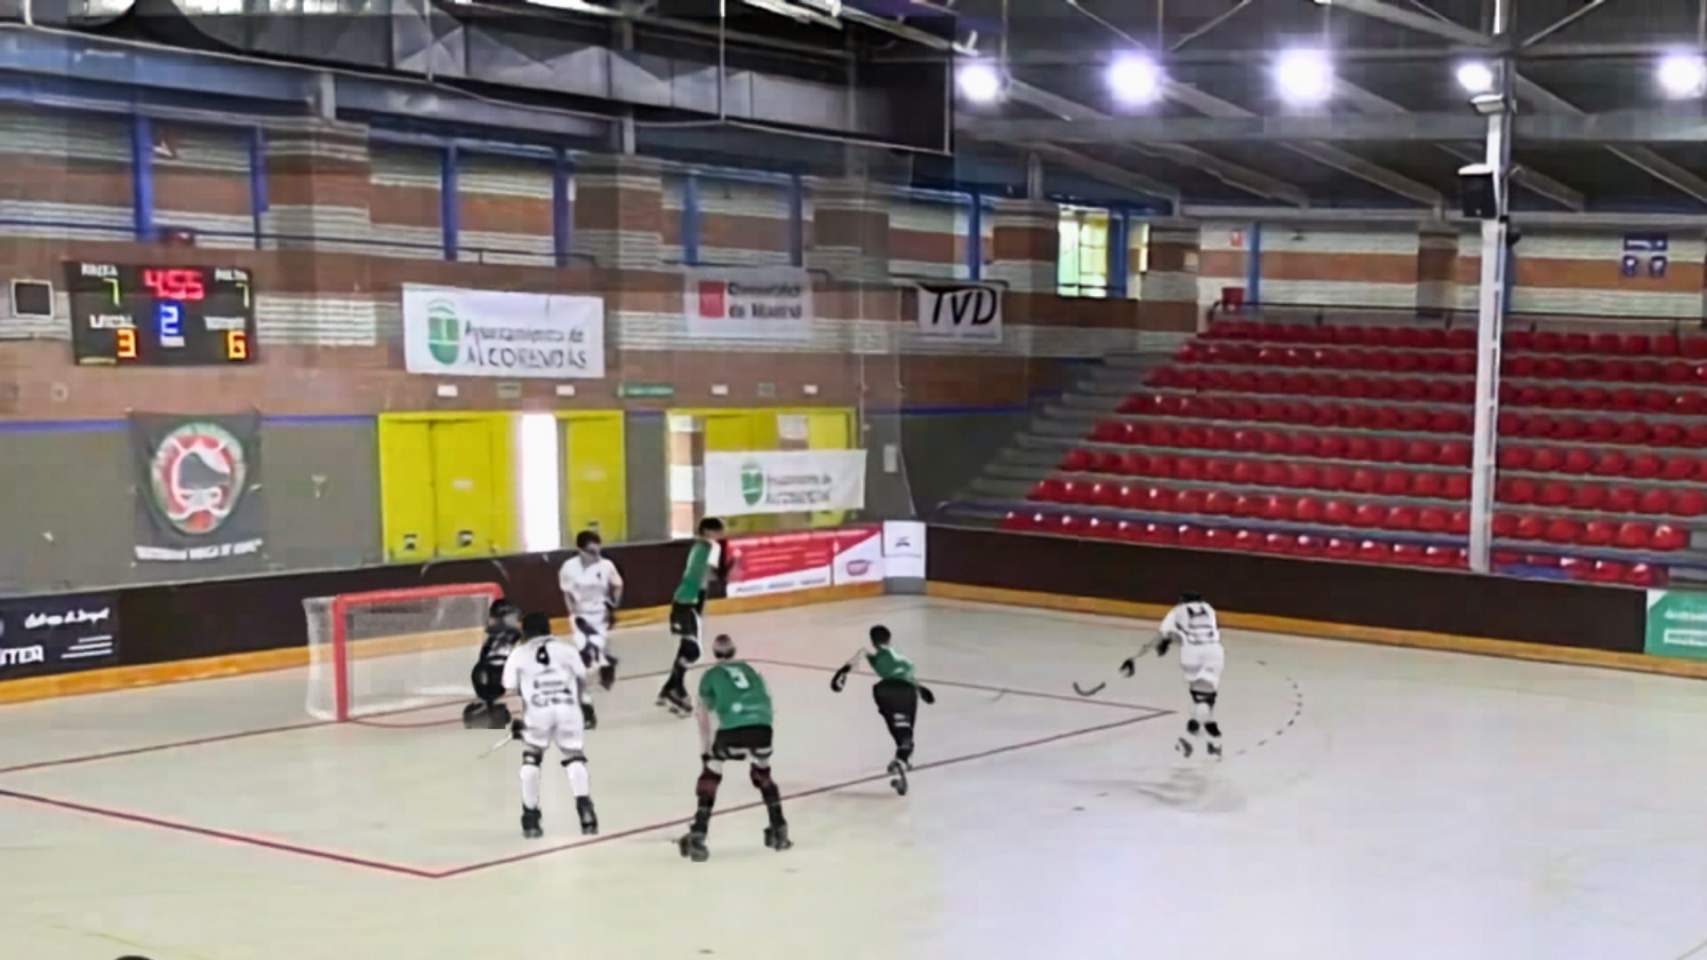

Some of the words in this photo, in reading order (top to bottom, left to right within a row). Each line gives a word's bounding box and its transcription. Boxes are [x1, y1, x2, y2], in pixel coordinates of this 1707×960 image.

[918, 281, 997, 325] TVD
[160, 303, 179, 334] 2
[117, 328, 137, 358] 3
[228, 330, 247, 359] 6
